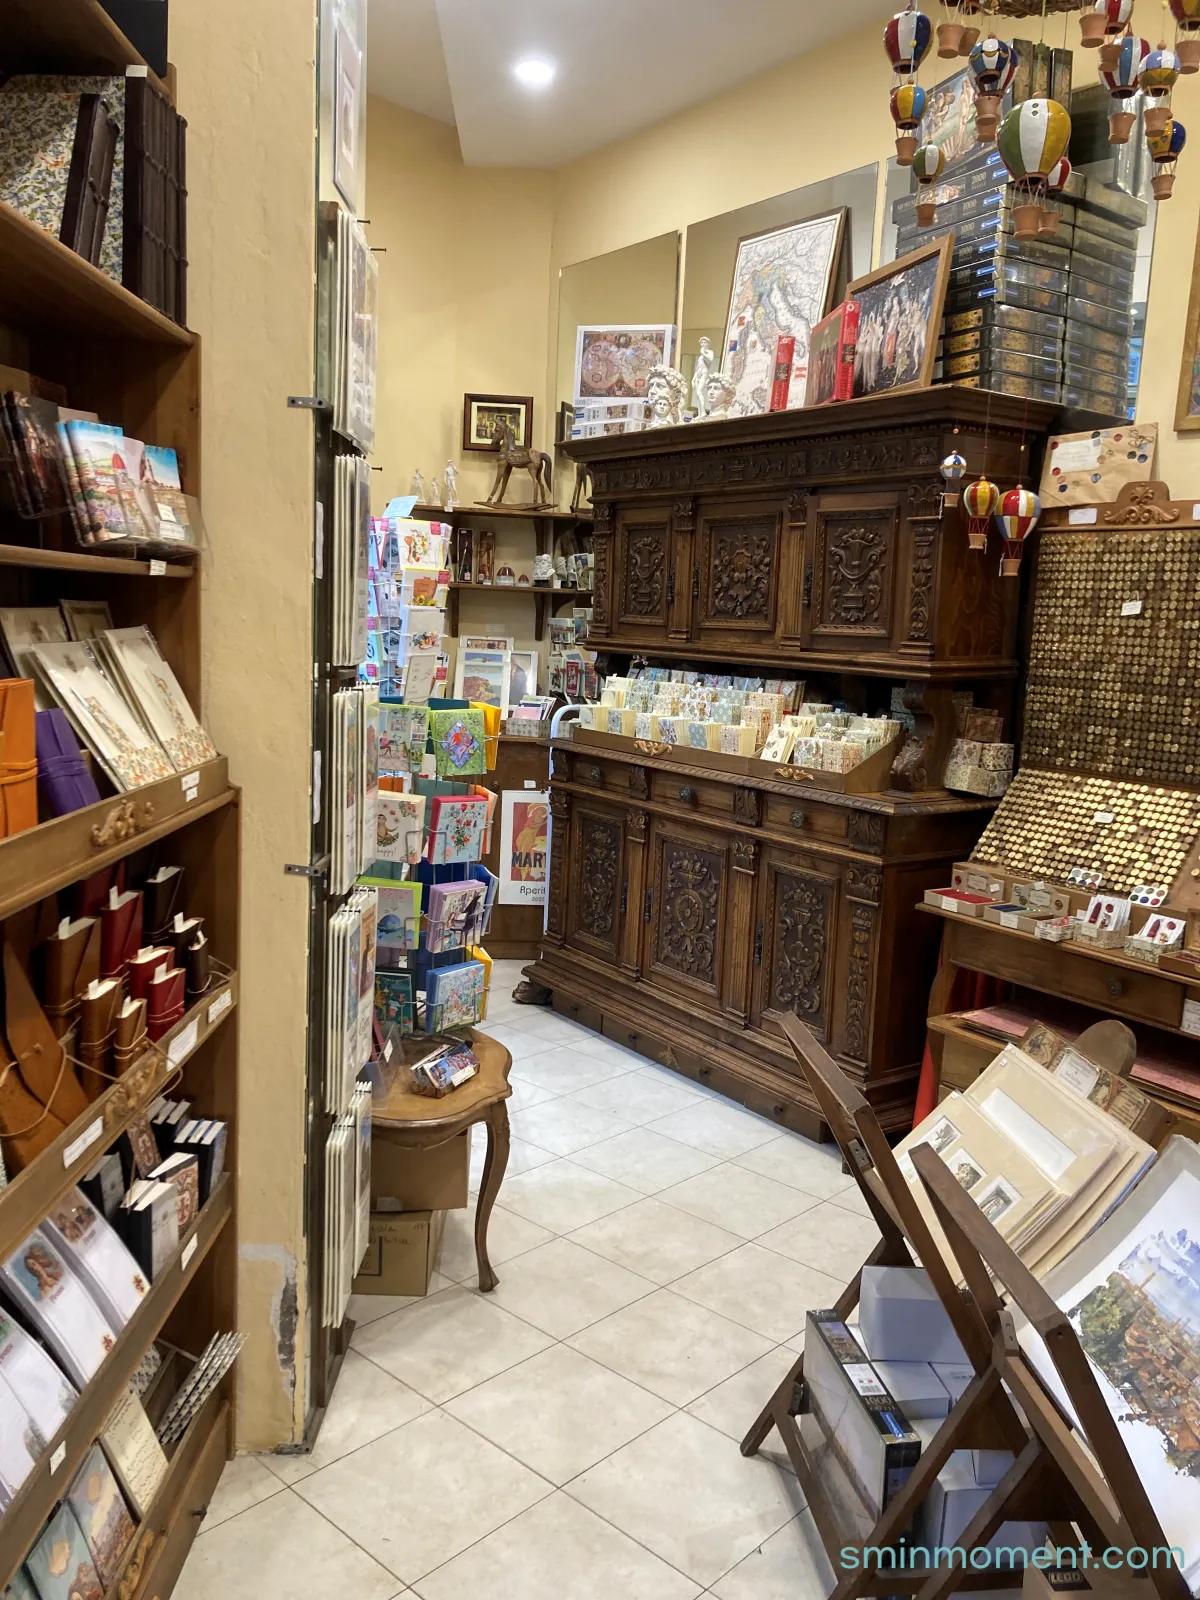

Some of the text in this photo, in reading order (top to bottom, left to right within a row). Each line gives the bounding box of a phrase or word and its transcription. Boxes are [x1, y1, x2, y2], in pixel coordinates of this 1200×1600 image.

[971, 171, 987, 185] 2000
[962, 199, 977, 210] 1000
[961, 222, 975, 233] 1000
[1050, 1571, 1083, 1584] LEGO
